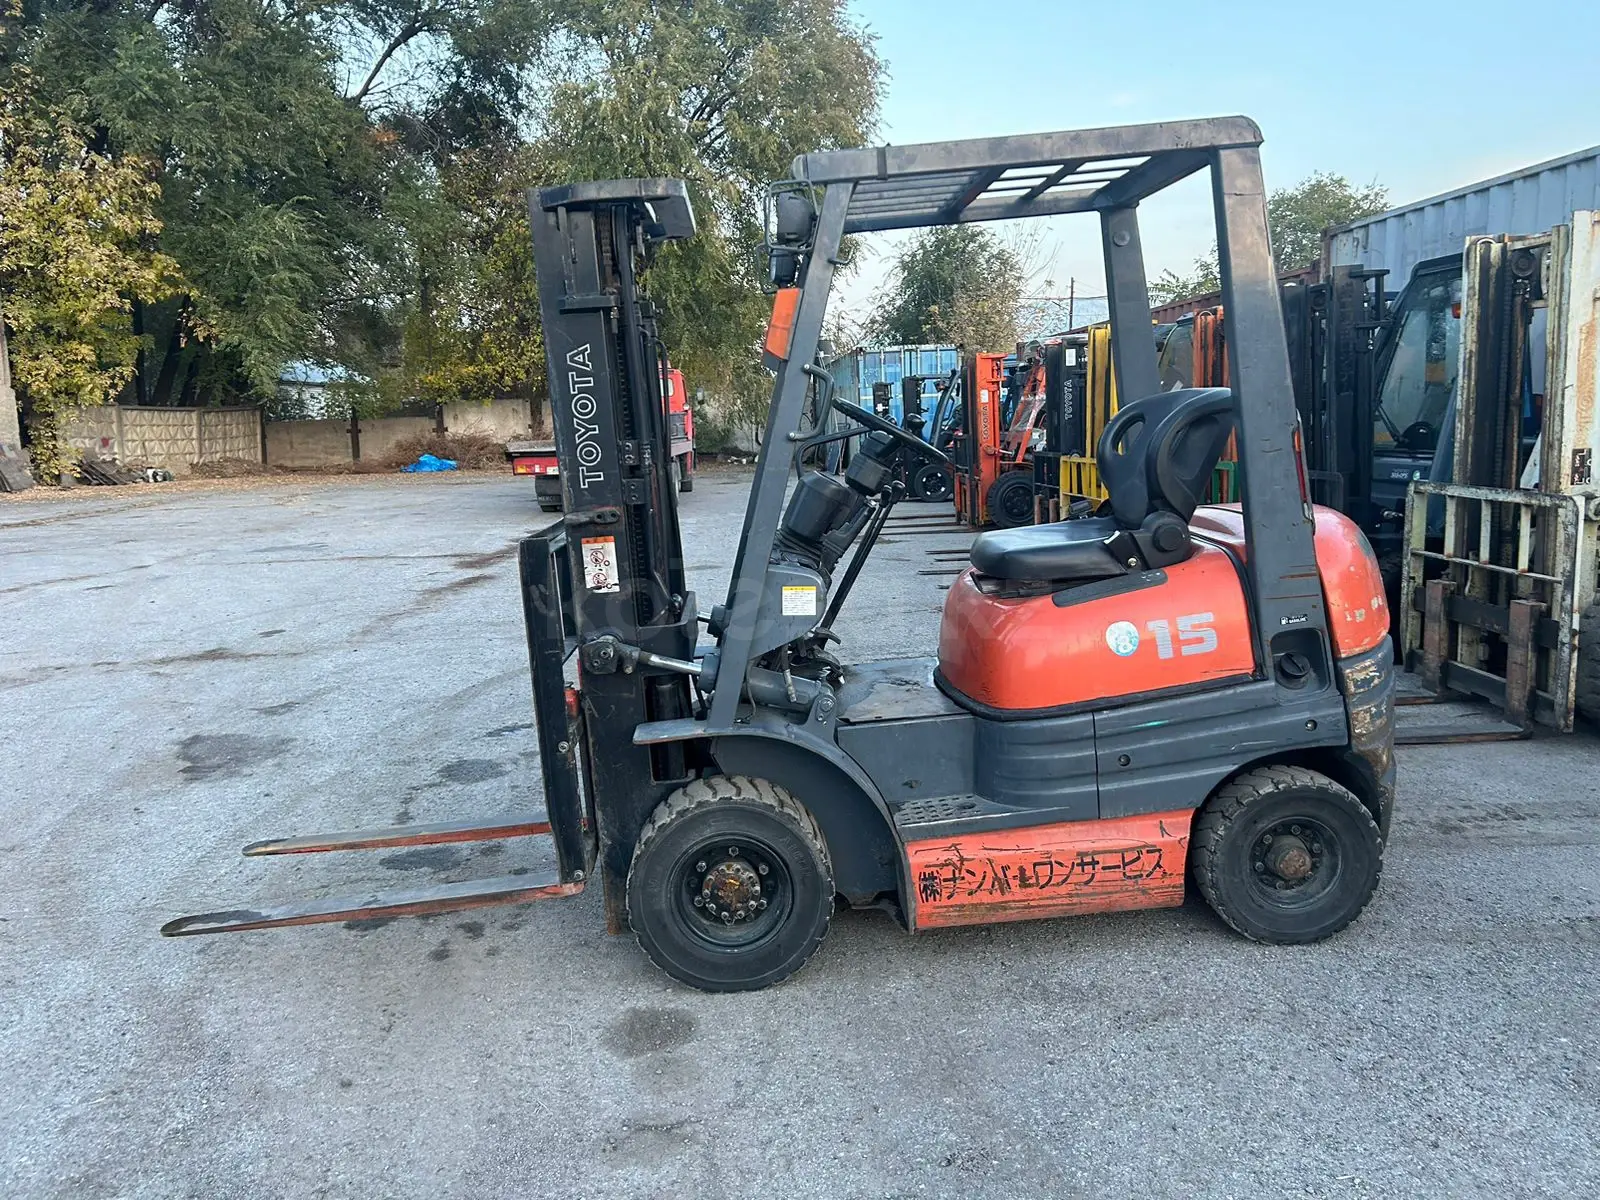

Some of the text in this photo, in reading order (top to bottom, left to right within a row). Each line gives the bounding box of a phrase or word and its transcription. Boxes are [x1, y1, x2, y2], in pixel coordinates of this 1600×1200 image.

[566, 343, 604, 488] TOYOTA
[1064, 379, 1072, 420] TOYOTA
[1146, 611, 1218, 659] 15
